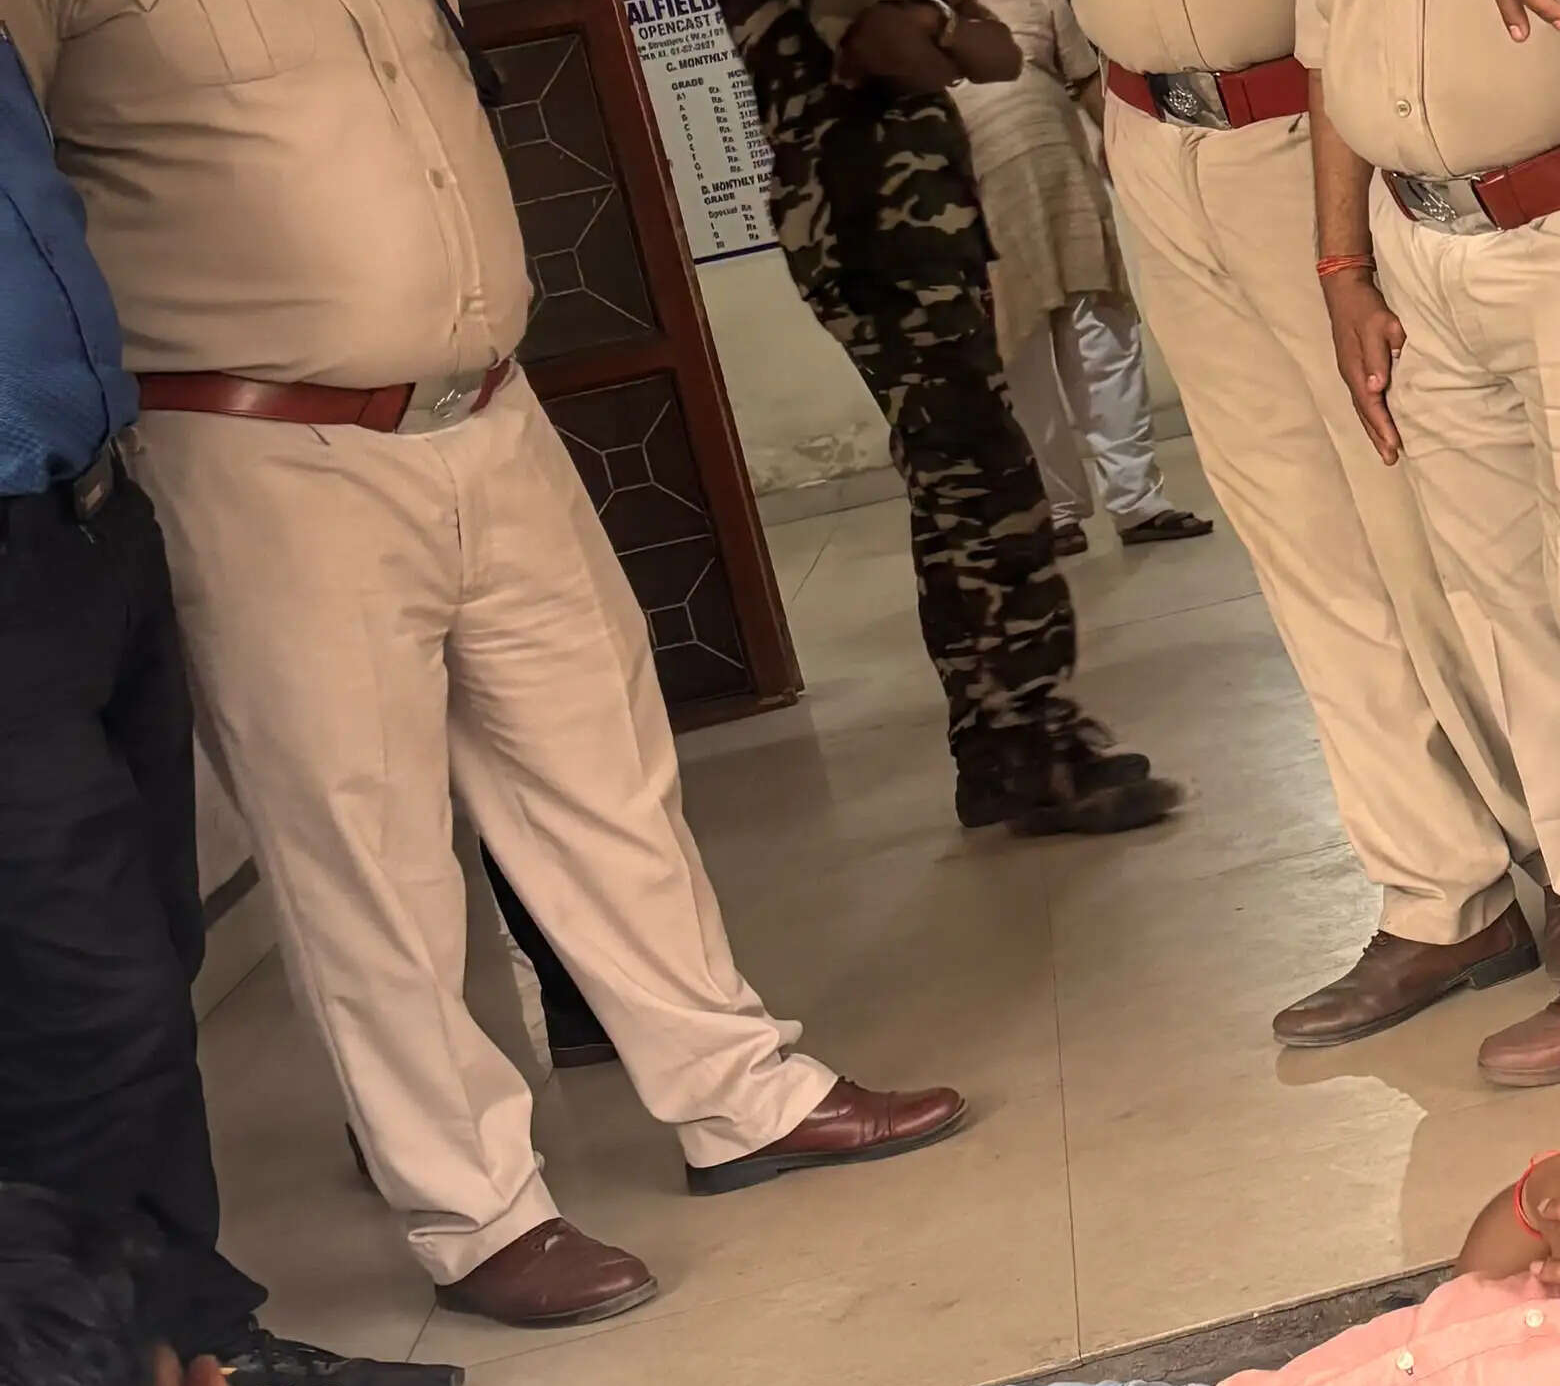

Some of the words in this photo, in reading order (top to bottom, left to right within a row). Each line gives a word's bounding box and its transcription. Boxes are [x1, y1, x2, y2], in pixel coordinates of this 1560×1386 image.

[638, 14, 710, 40] OPENCAST
[679, 52, 729, 69] MONTHLY
[671, 77, 704, 91] GRADE
[711, 175, 754, 192] MONTHLY
[704, 192, 735, 205] GRADE
